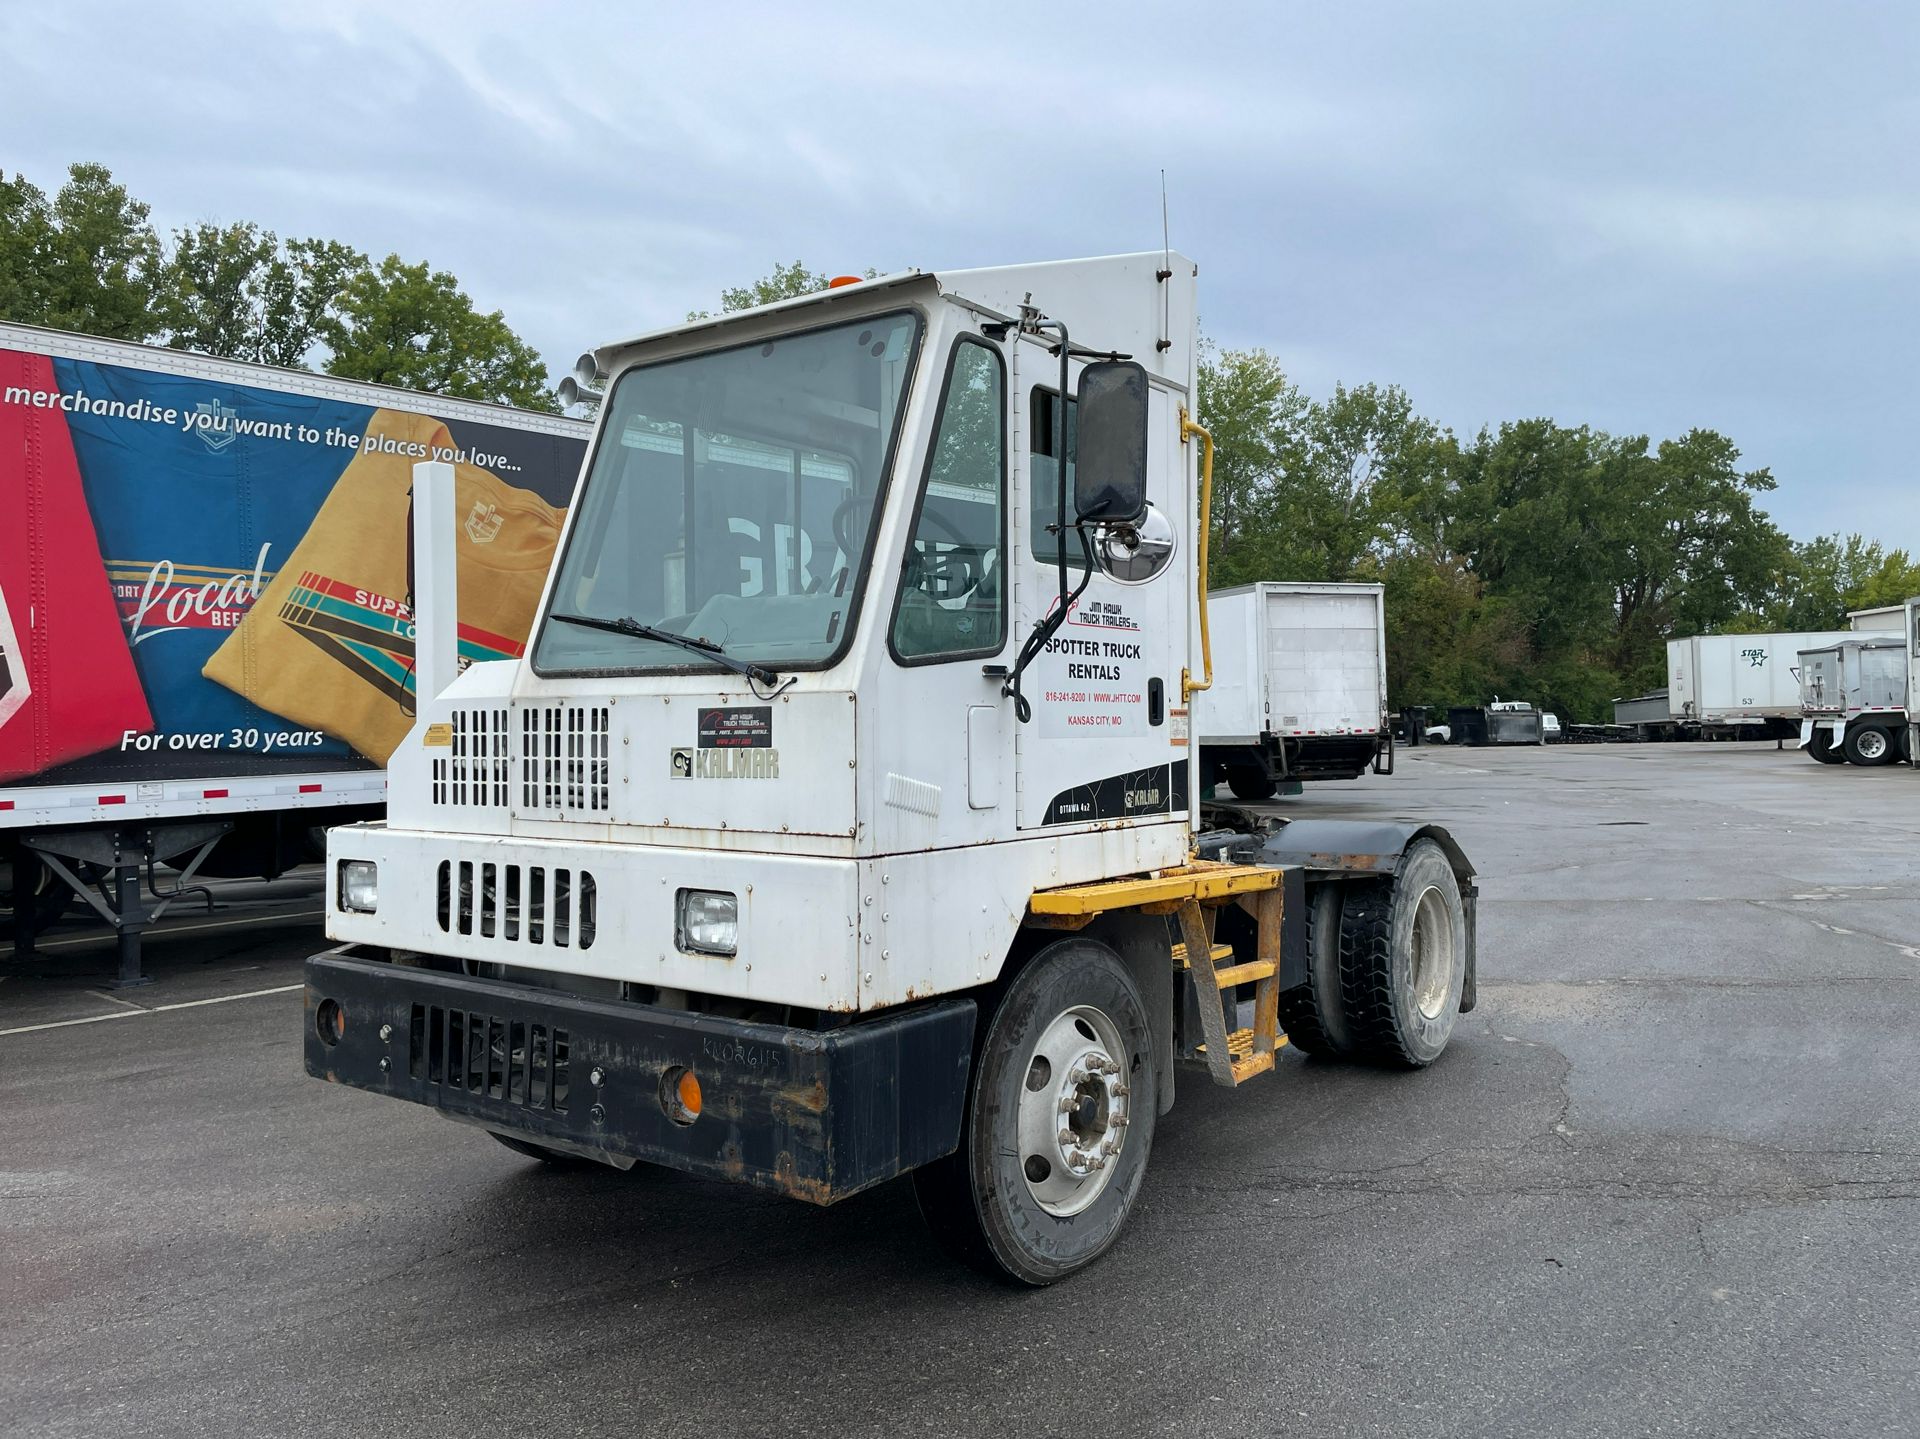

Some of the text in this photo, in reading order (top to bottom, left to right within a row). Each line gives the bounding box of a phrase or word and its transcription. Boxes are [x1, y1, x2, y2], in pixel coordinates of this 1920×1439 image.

[4, 386, 178, 425] merchandise
[182, 410, 228, 432] you
[234, 418, 293, 441] want
[298, 426, 320, 444] to
[325, 427, 360, 449] the
[363, 433, 427, 457] places
[431, 446, 466, 463] you
[122, 542, 273, 647] Local
[1089, 601, 1122, 615] JIM HAWK
[1080, 613, 1100, 625] TRUCK
[1102, 615, 1131, 628] TRAILERS
[1045, 638, 1141, 659] SPOTTER TRUCK
[1741, 649, 1764, 657] STAR
[1068, 663, 1120, 680] RENTALS
[1045, 691, 1086, 702] 816-241-9200
[1093, 693, 1141, 703] WWW.JHTT.COM
[1068, 716, 1122, 727] KANSAS CITY, MO
[121, 728, 323, 753] For over 30 years
[697, 748, 778, 778] KALMAR
